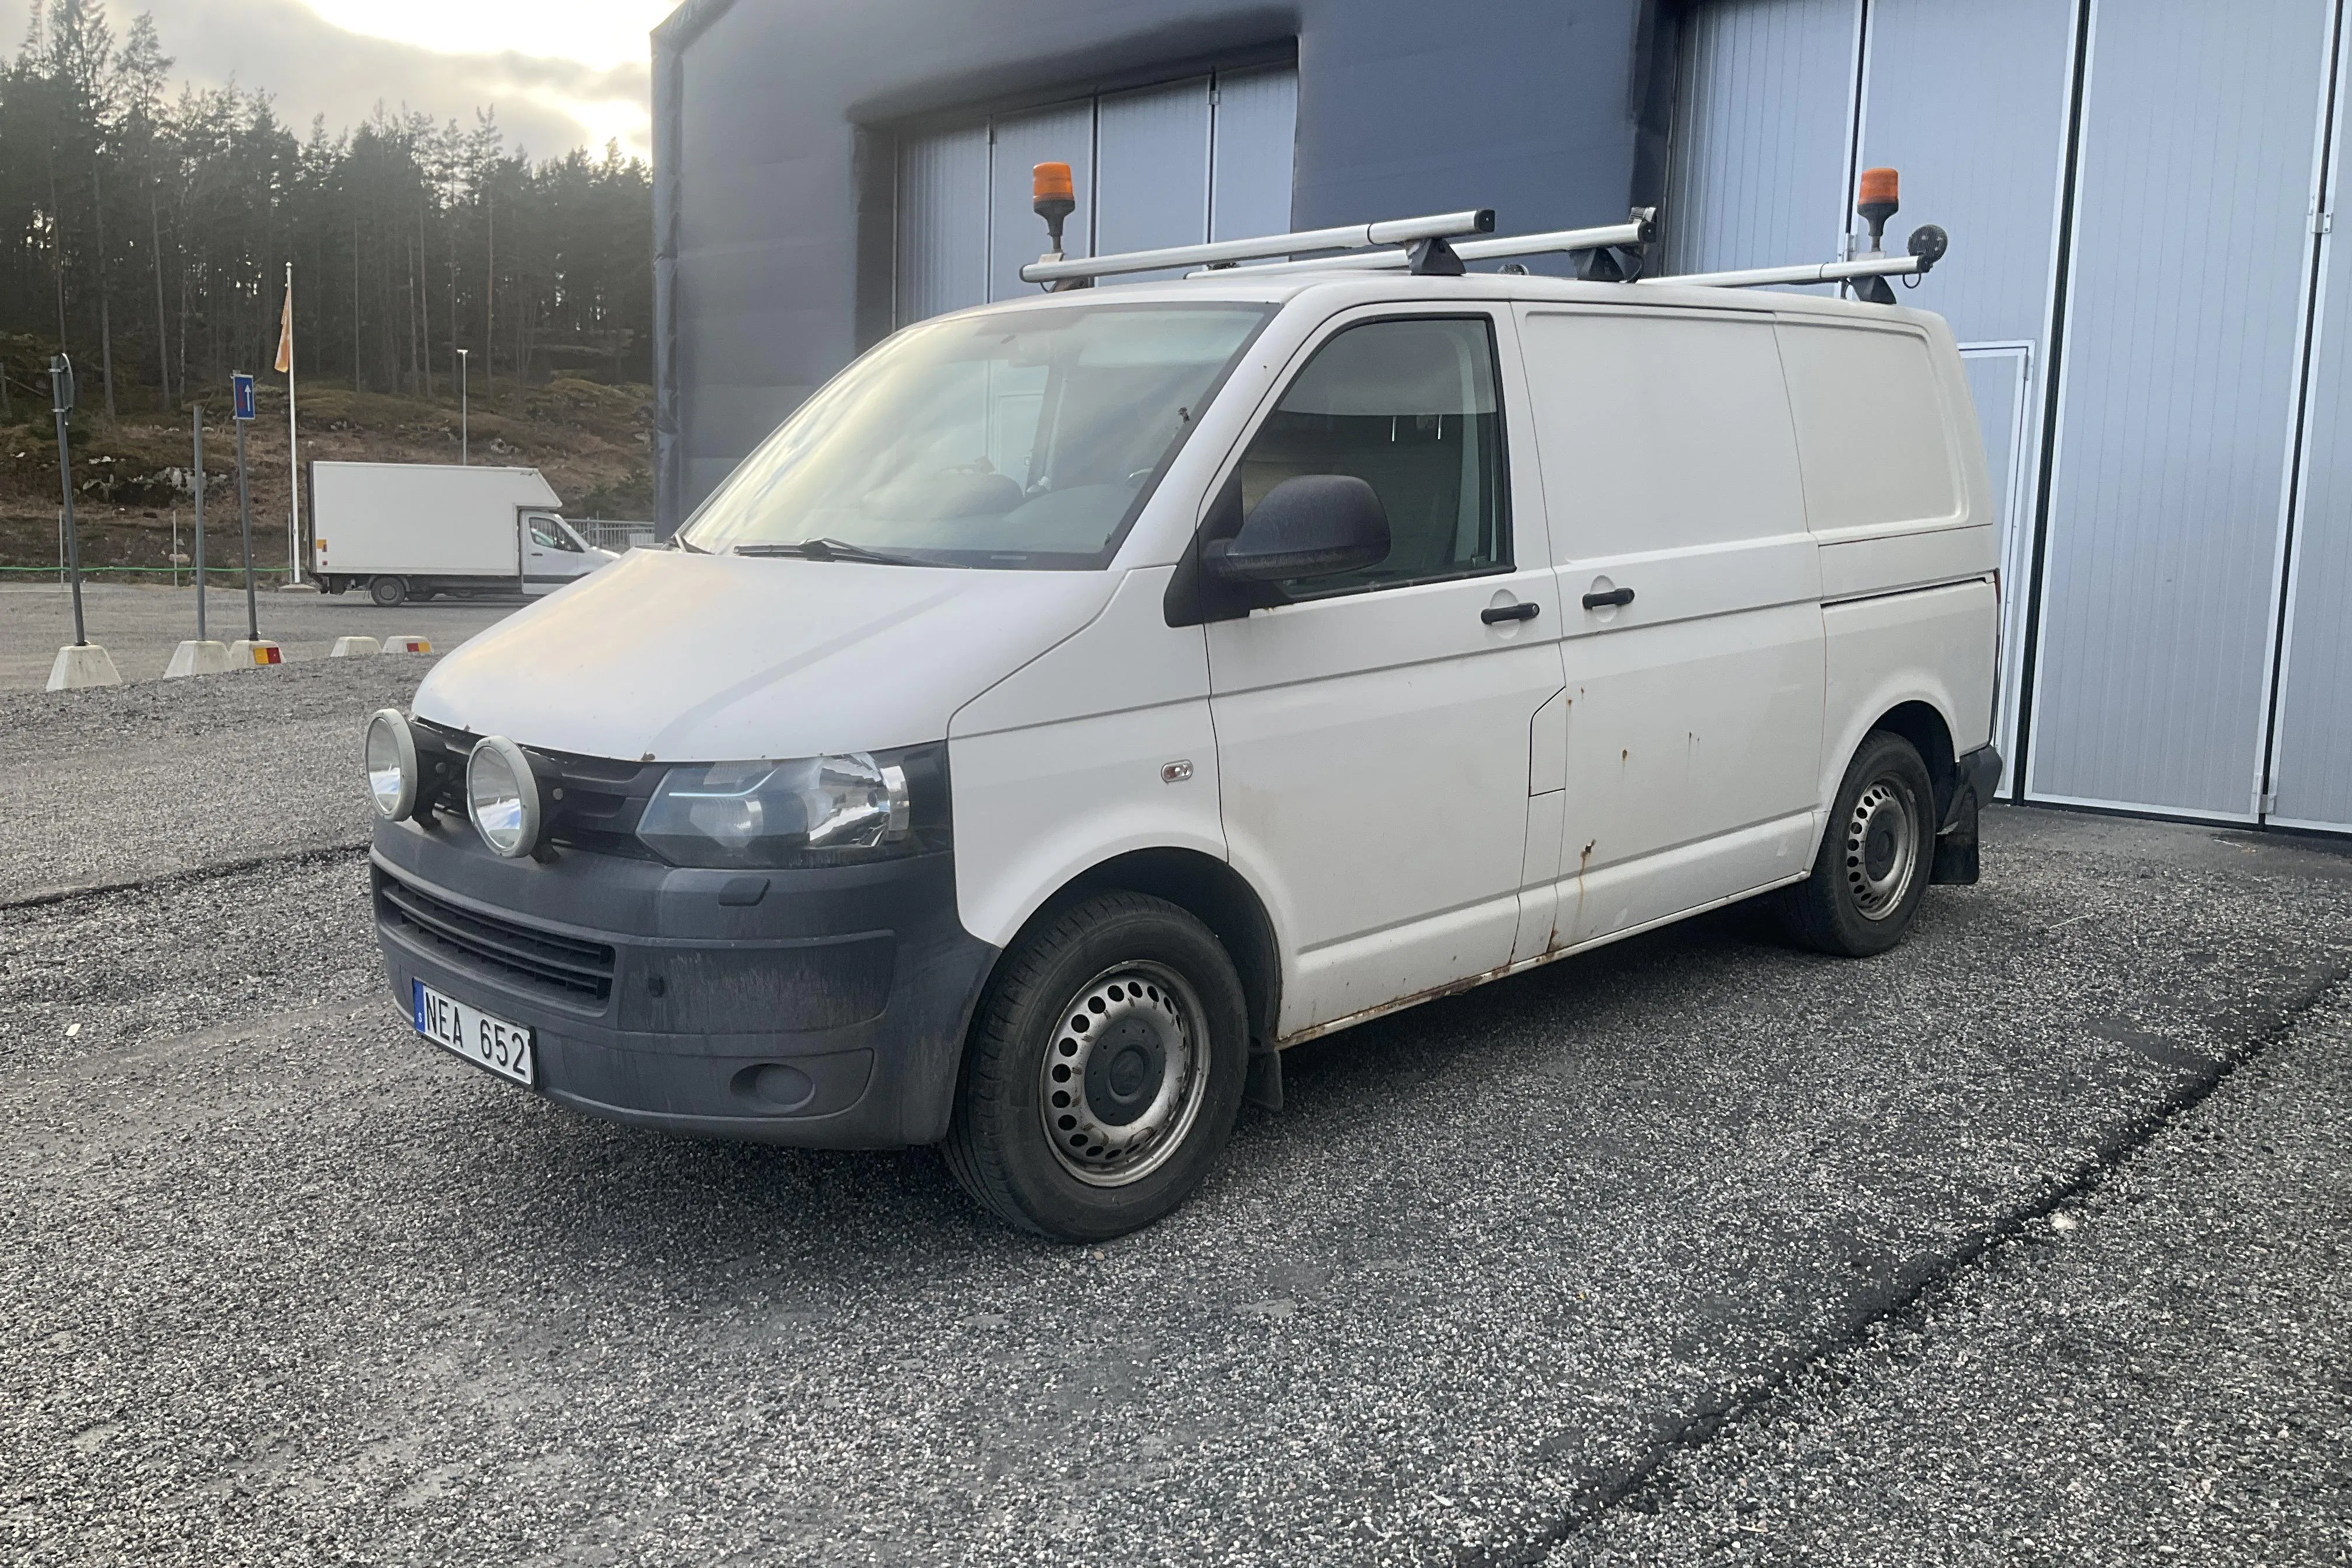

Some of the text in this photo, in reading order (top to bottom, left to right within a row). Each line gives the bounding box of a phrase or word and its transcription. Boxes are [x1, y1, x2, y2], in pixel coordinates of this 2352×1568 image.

[418, 1012, 422, 1023] S
[426, 992, 526, 1076] NEA 652
